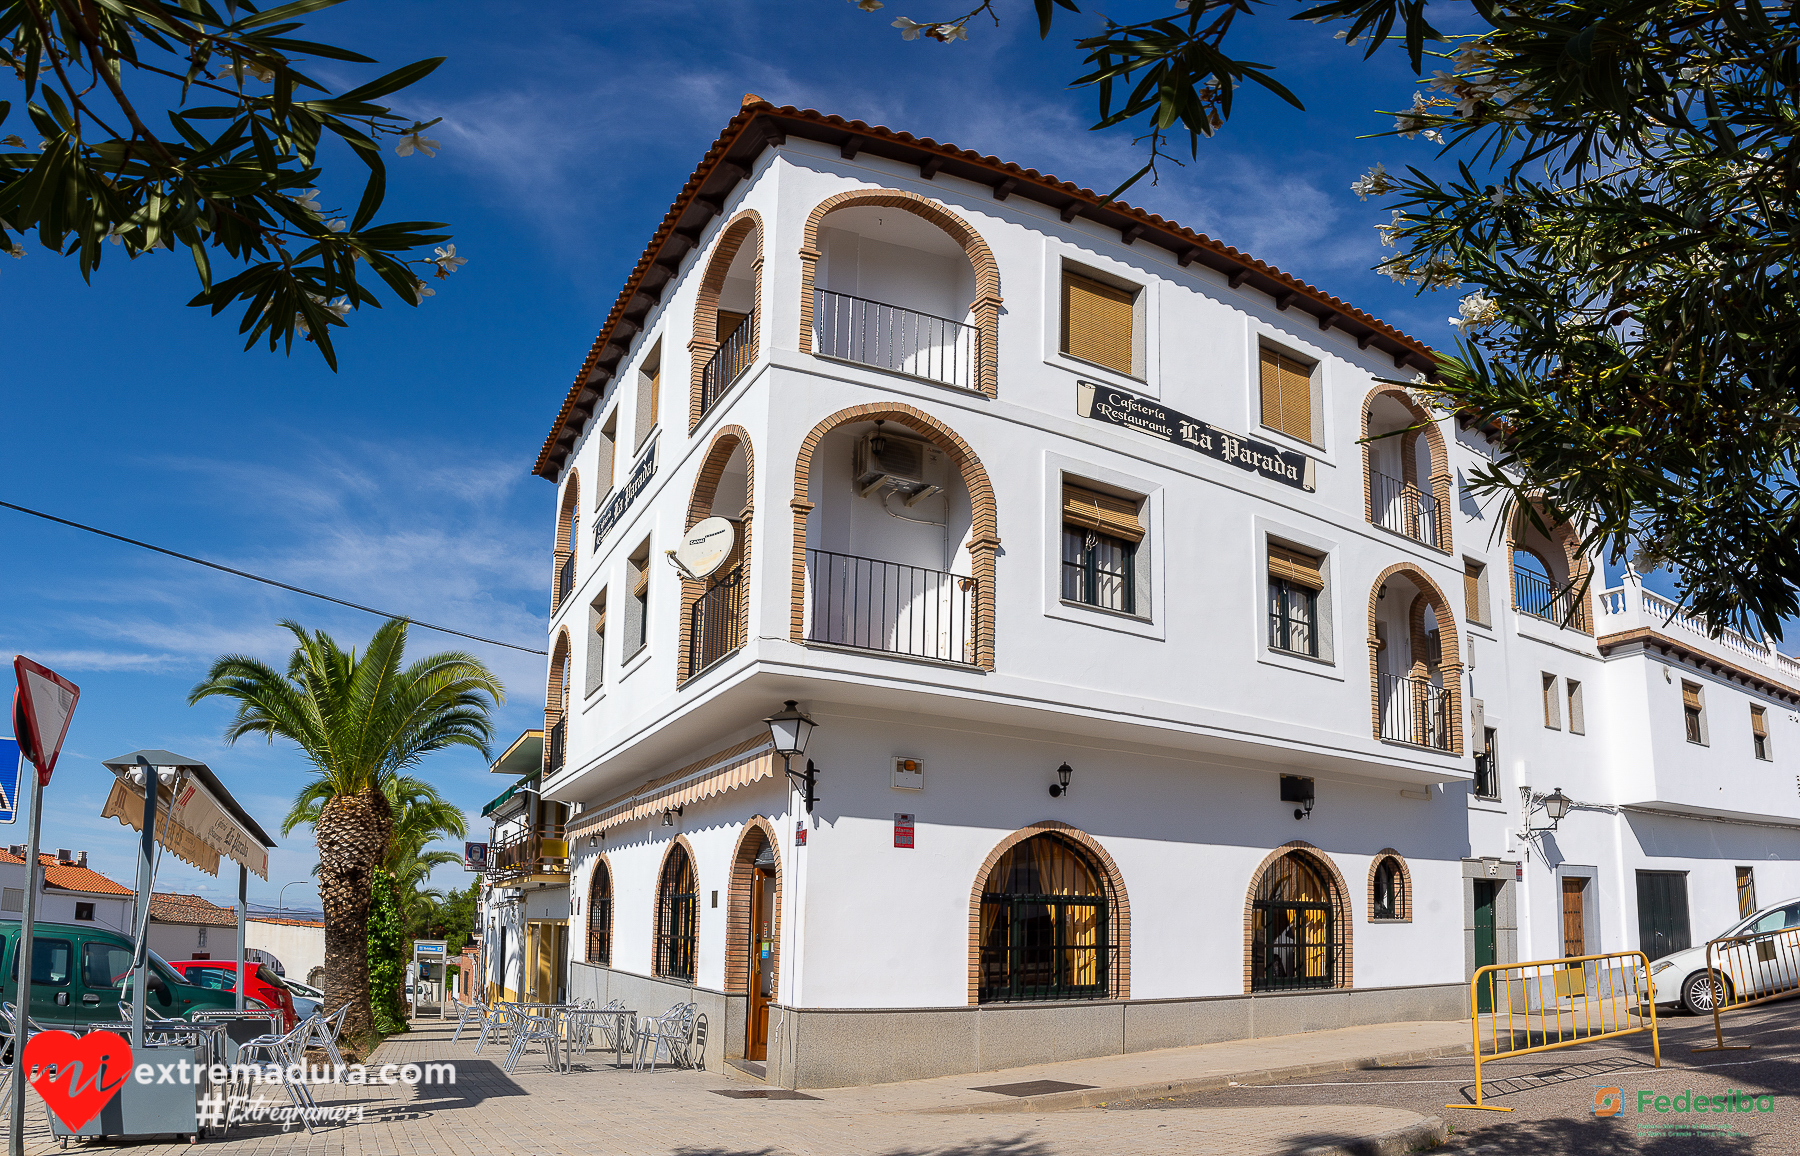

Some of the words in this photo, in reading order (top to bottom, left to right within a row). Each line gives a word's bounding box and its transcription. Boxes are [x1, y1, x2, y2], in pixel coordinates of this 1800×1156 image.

[1096, 402, 1173, 436] Restaurante
[1108, 393, 1166, 421] Cafetería
[1179, 420, 1212, 451] La
[1220, 435, 1298, 482] Parada
